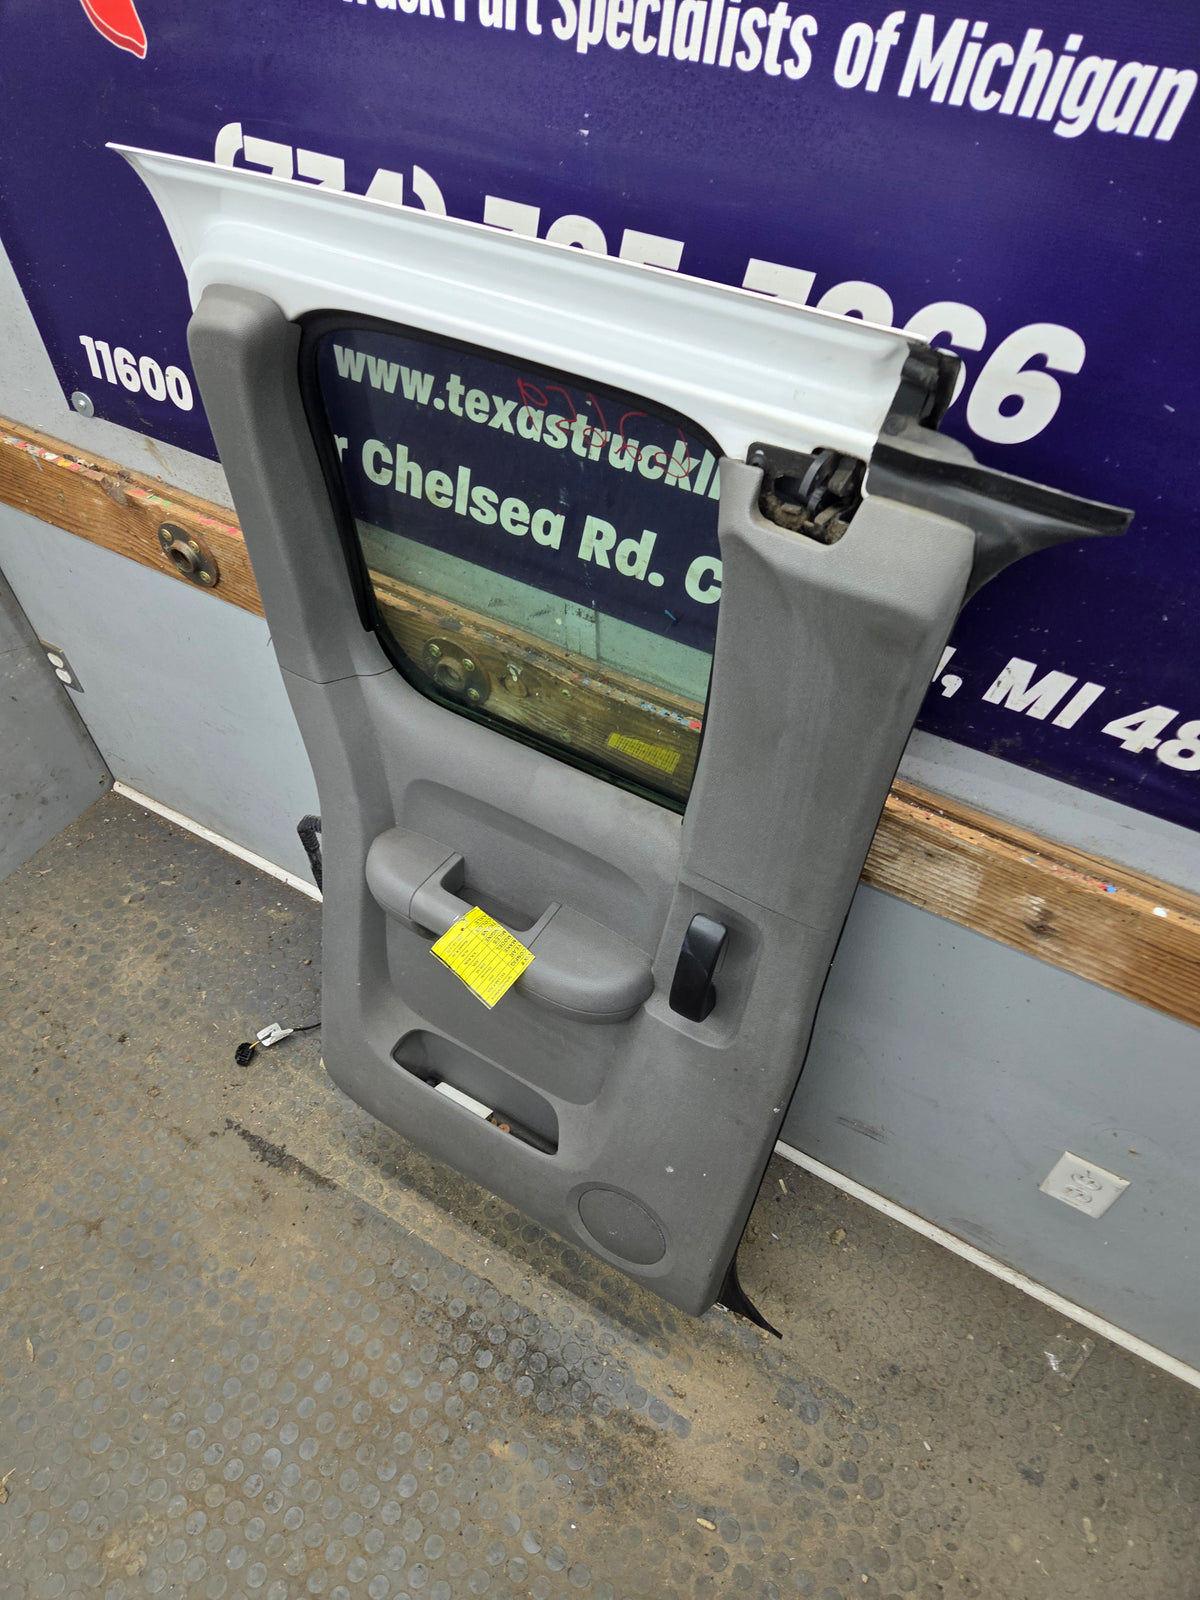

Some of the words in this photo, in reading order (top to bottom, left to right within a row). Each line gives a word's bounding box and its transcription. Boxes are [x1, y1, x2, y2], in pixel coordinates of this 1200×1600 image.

[551, 0, 817, 80] Specialists
[833, 10, 905, 92] of
[898, 13, 1198, 141] Michigan
[79, 335, 193, 411] 11600
[361, 439, 566, 550] Chelsea
[578, 515, 665, 588] Rd.
[982, 657, 1106, 729] MI
